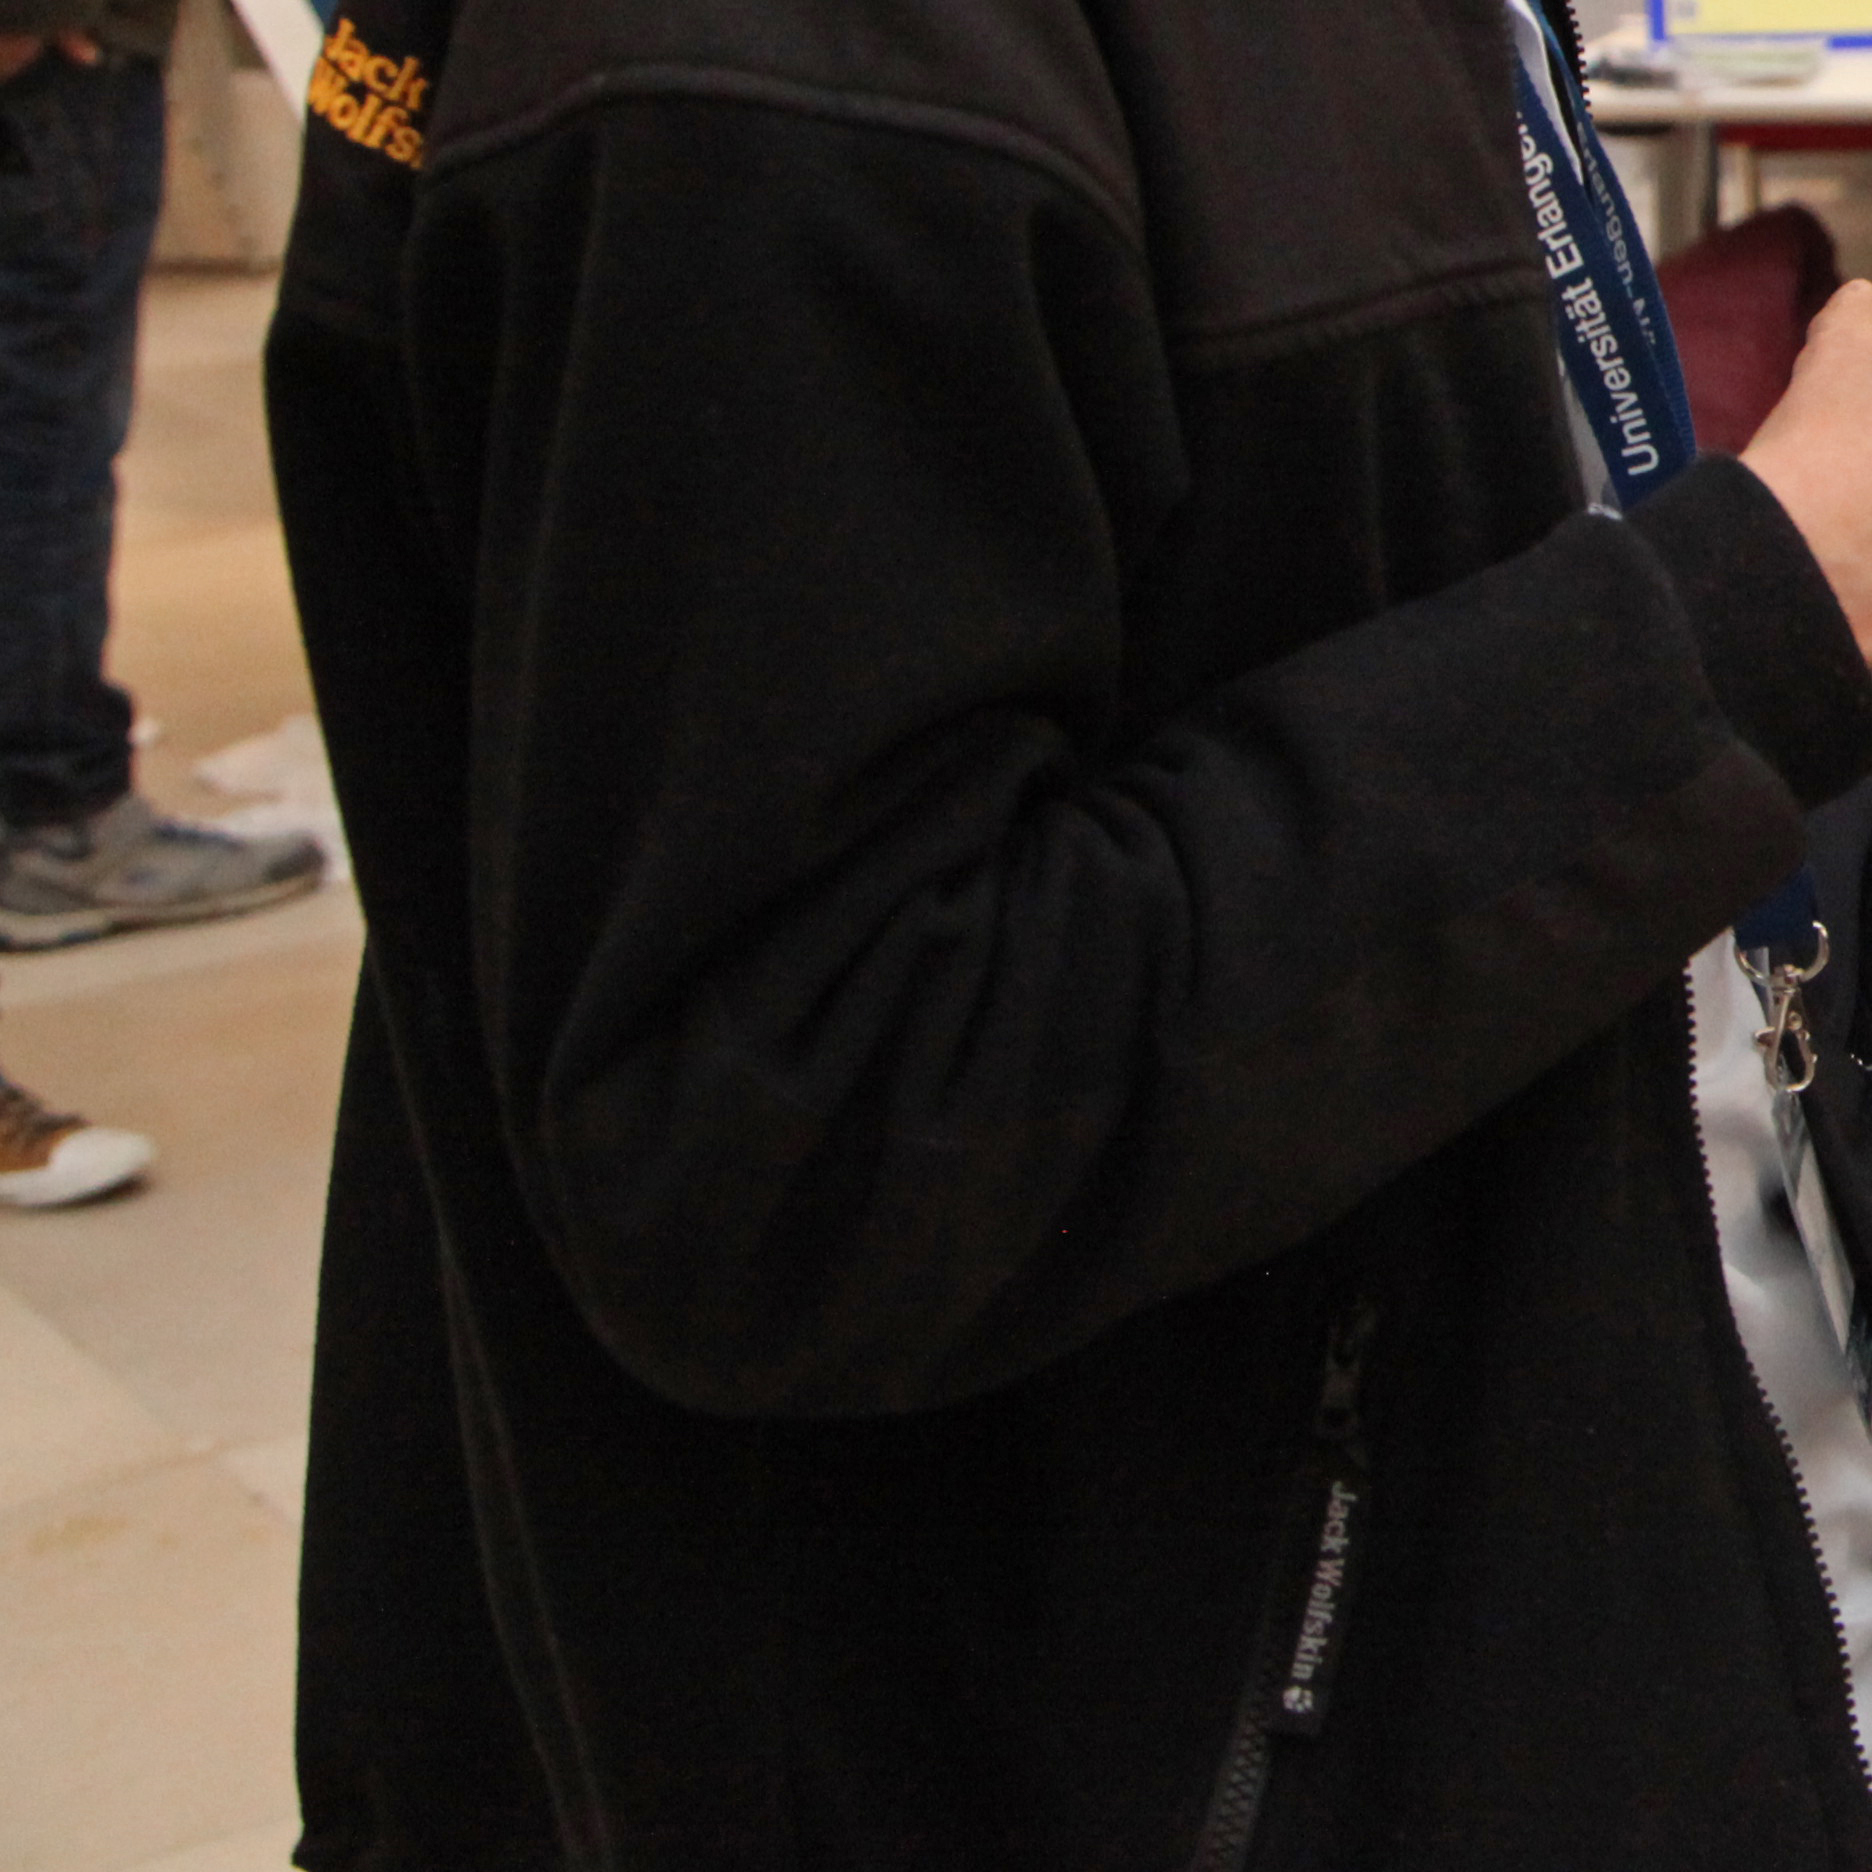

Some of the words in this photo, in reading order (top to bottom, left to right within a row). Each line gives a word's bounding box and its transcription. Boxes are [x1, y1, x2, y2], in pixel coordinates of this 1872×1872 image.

[308, 57, 425, 170] Wolfs
[324, 18, 431, 109] Jack
[1516, 111, 1586, 278] Erlange
[1560, 277, 1659, 476] Universität
[1320, 1480, 1358, 1554] Jack
[1290, 1558, 1345, 1681] Wolfskin
